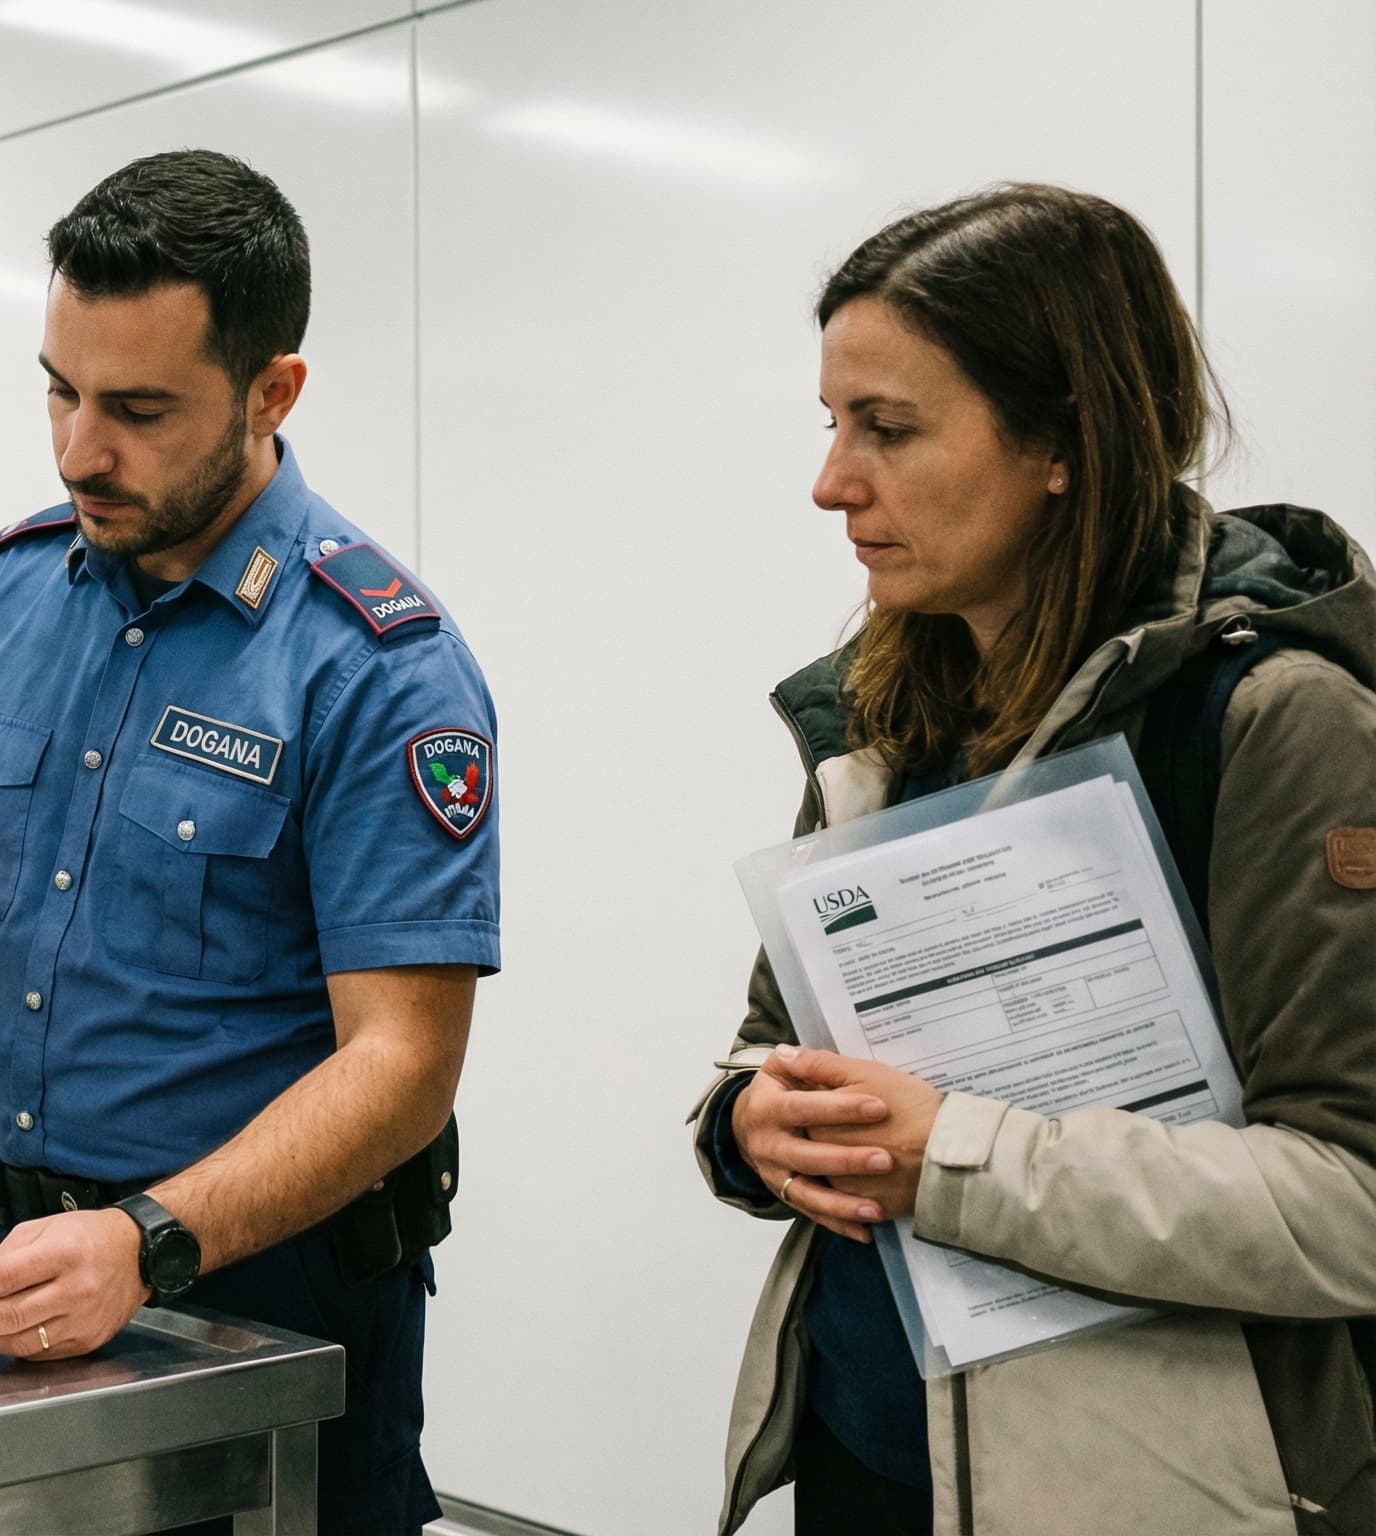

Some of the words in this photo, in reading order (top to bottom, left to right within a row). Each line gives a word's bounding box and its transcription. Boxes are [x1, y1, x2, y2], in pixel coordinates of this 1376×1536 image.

[169, 720, 261, 769] DOGANA
[424, 738, 480, 759] DOGANA
[812, 884, 870, 914] USDA
